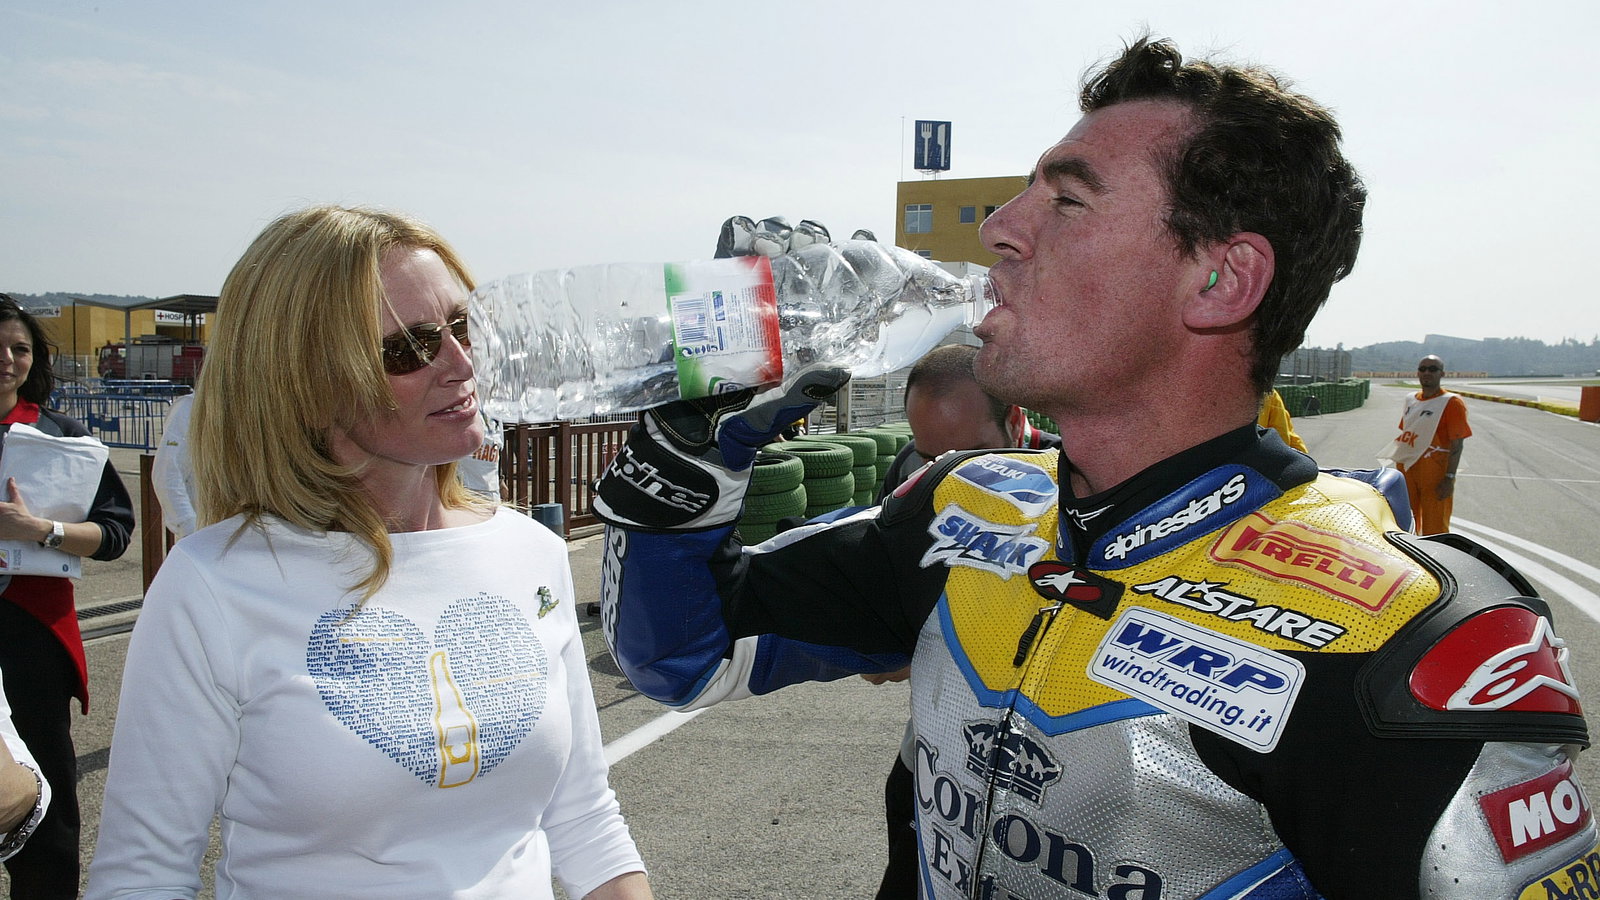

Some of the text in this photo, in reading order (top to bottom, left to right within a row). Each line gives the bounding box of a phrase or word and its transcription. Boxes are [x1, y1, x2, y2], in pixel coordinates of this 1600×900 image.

[973, 459, 1027, 480] SUZUKI
[938, 515, 1040, 568] SHARK
[1104, 473, 1246, 560] alpinestars
[1238, 525, 1385, 590] PIRELLI
[1116, 622, 1285, 691] WRP
[1102, 653, 1273, 733] windtrading.it
[916, 738, 1163, 900] Corona
